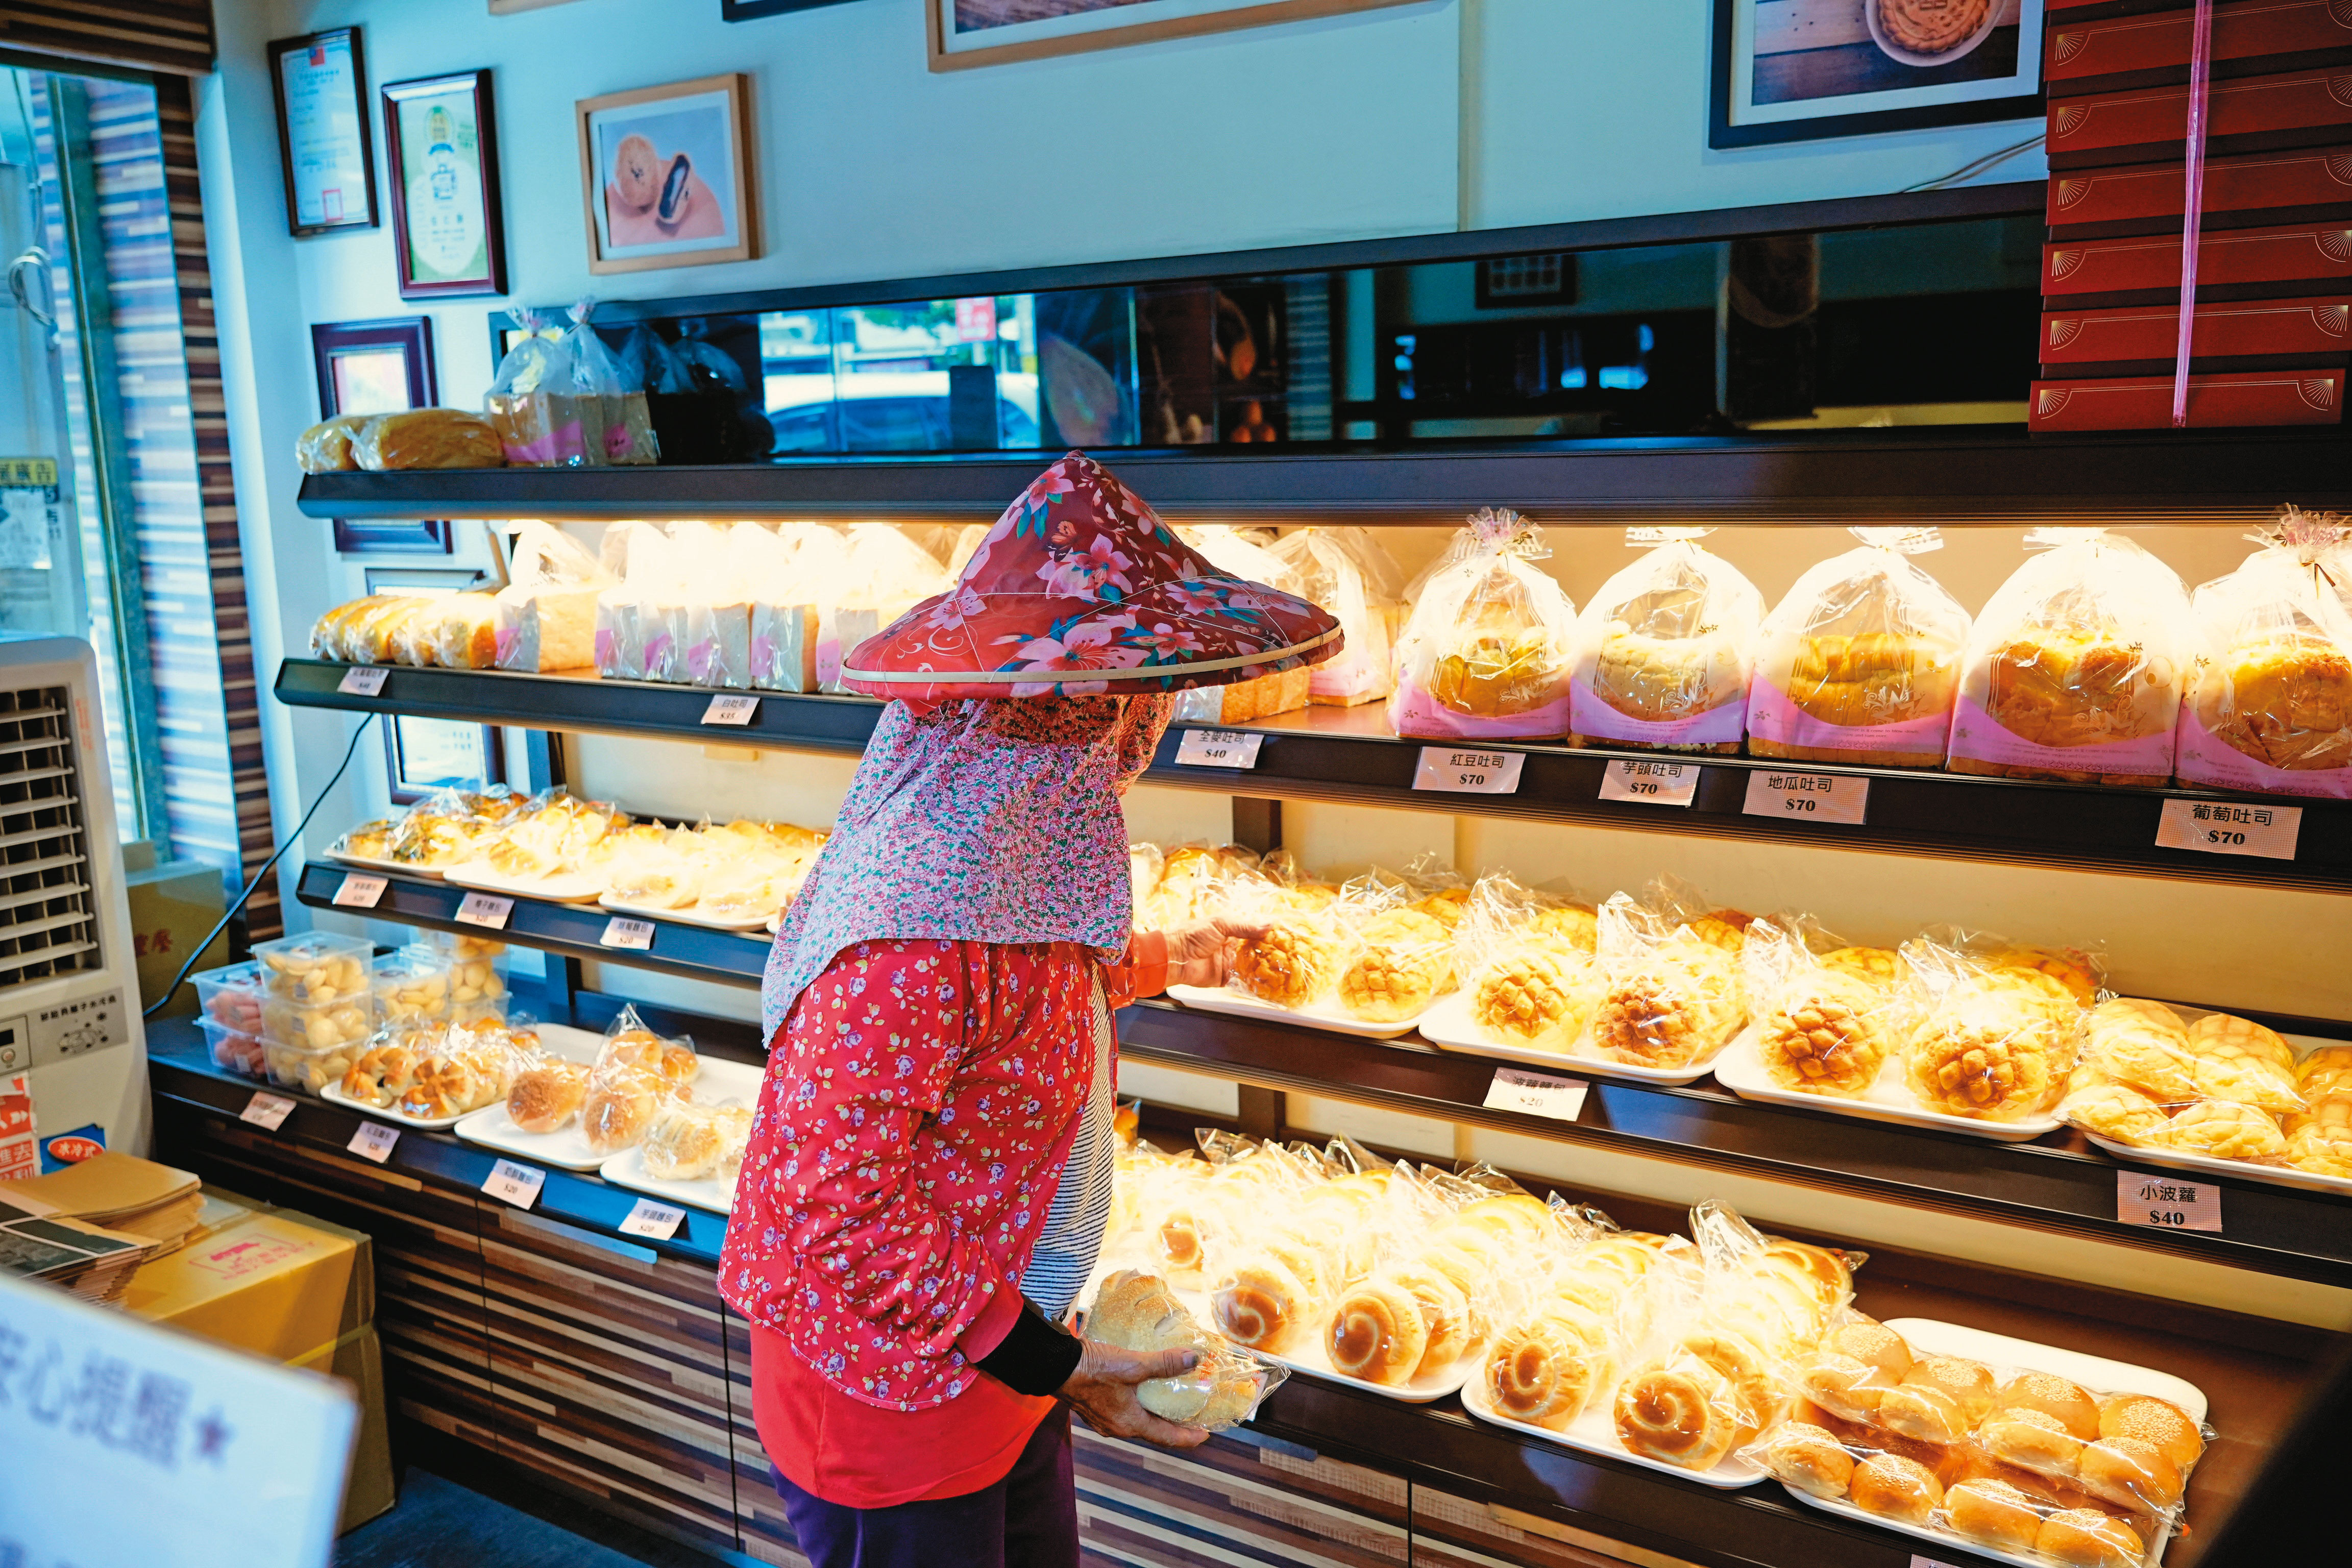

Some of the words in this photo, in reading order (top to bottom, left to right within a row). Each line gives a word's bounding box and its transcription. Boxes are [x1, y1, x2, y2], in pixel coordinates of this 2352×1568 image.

[722, 699, 748, 708] 白吐司
[1198, 730, 1245, 744] 全麥吐司
[1205, 749, 1226, 758] $40
[1450, 754, 1505, 768] 紅豆吐司
[1623, 762, 1682, 777] 芋頭吐司
[1459, 774, 1484, 785] $70
[1768, 775, 1832, 792] 地瓜吐司
[1630, 782, 1657, 794] $70
[1785, 798, 1816, 811] $70
[2193, 804, 2272, 826] 葡萄吐司
[2208, 830, 2245, 845] $70
[1518, 1096, 1544, 1107] $20
[2140, 1184, 2196, 1203] 小波蘿
[2150, 1210, 2185, 1224] $40
